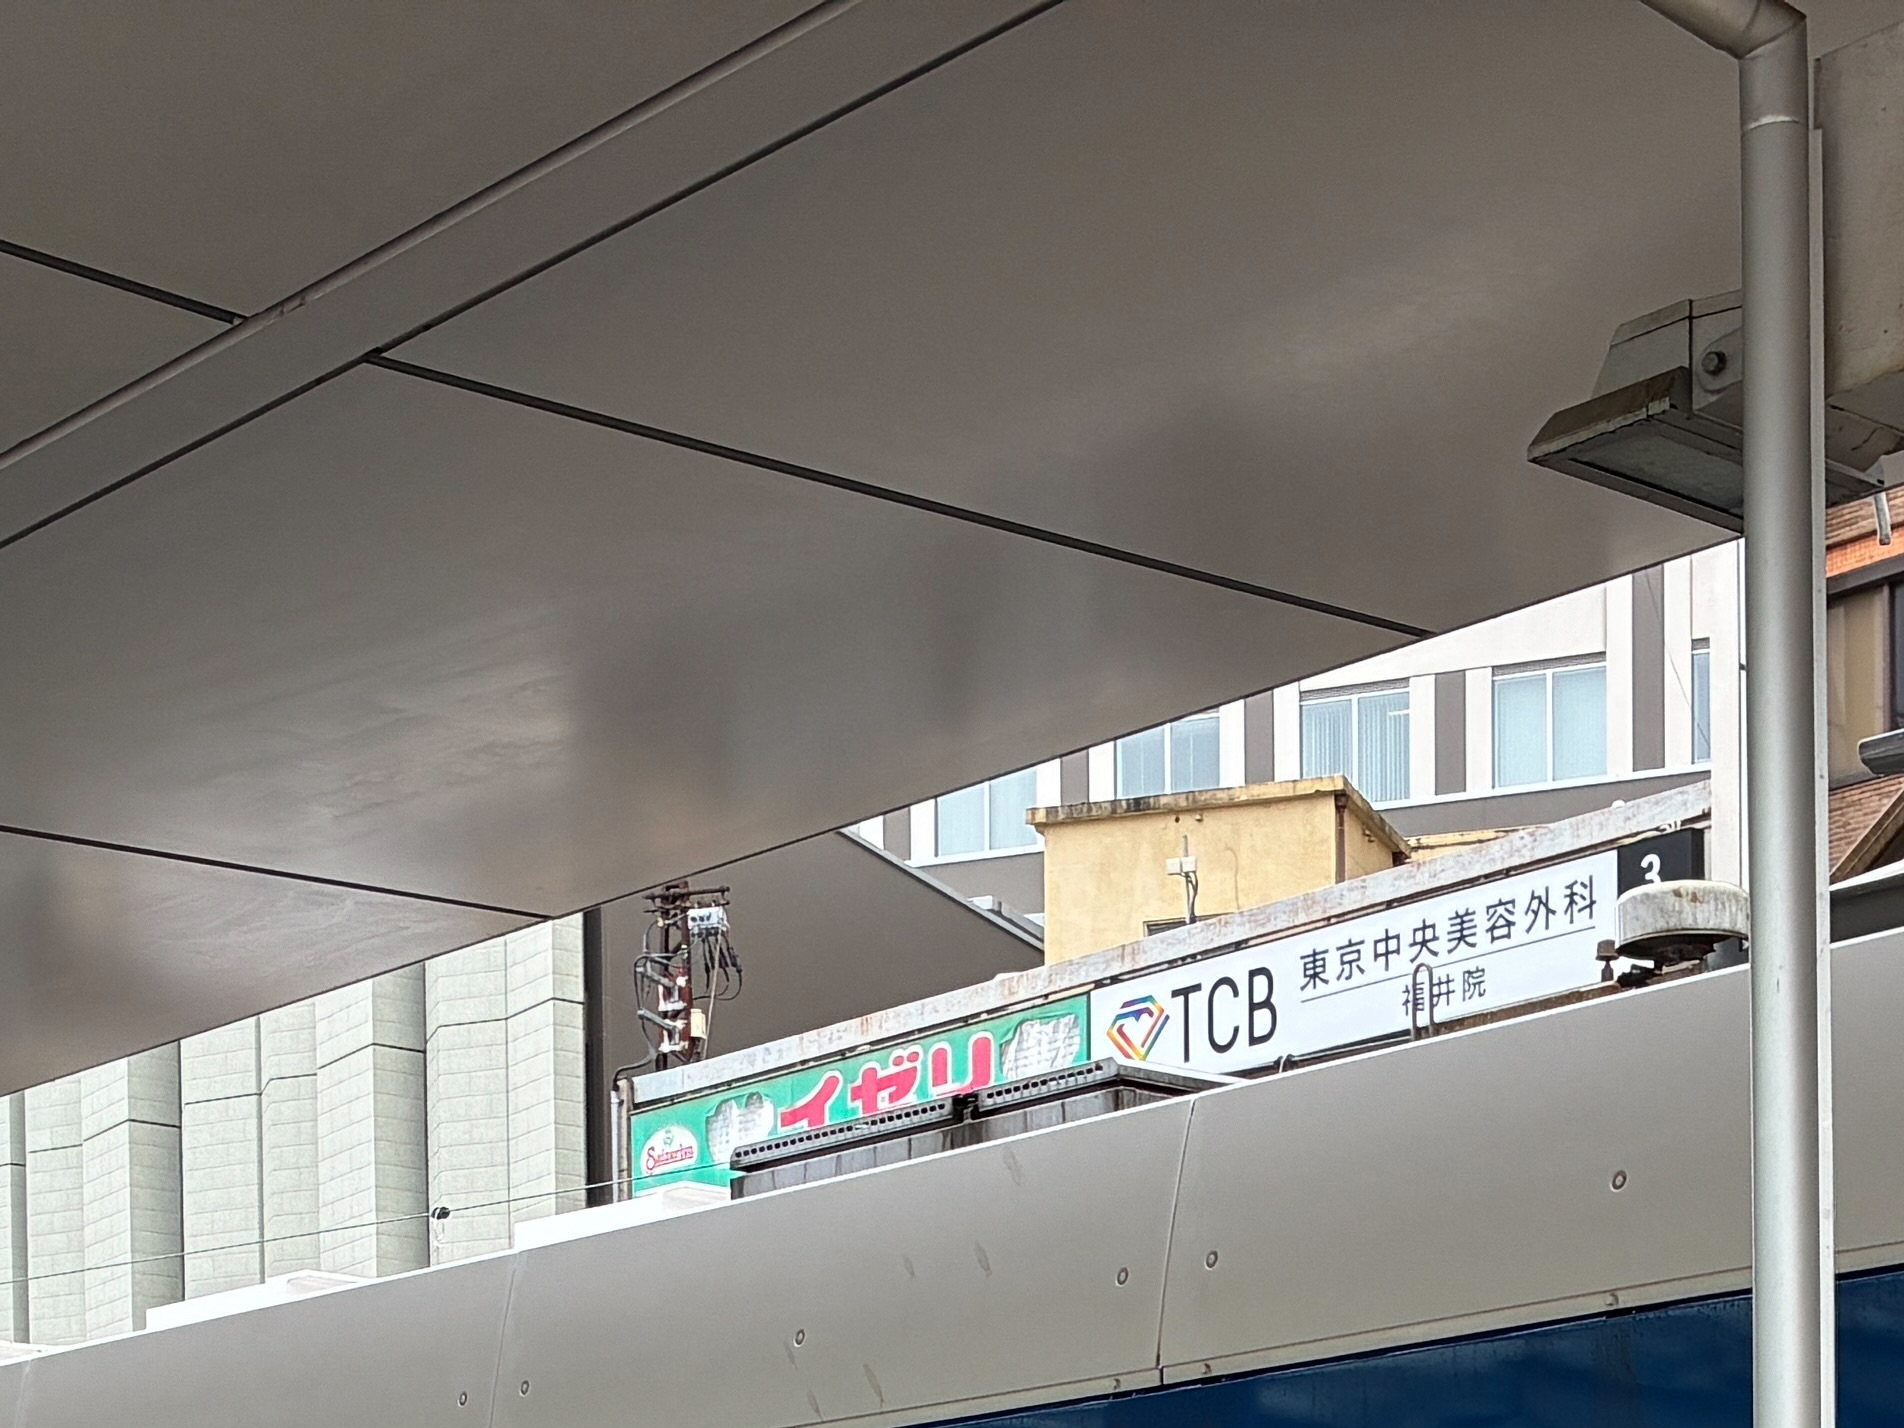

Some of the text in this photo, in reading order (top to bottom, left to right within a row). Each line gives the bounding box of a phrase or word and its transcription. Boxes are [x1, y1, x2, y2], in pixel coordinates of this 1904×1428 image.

[1300, 875, 1597, 991] 東京中央美容外科
[1171, 966, 1277, 1064] TCB
[1401, 966, 1488, 1019] 福井院
